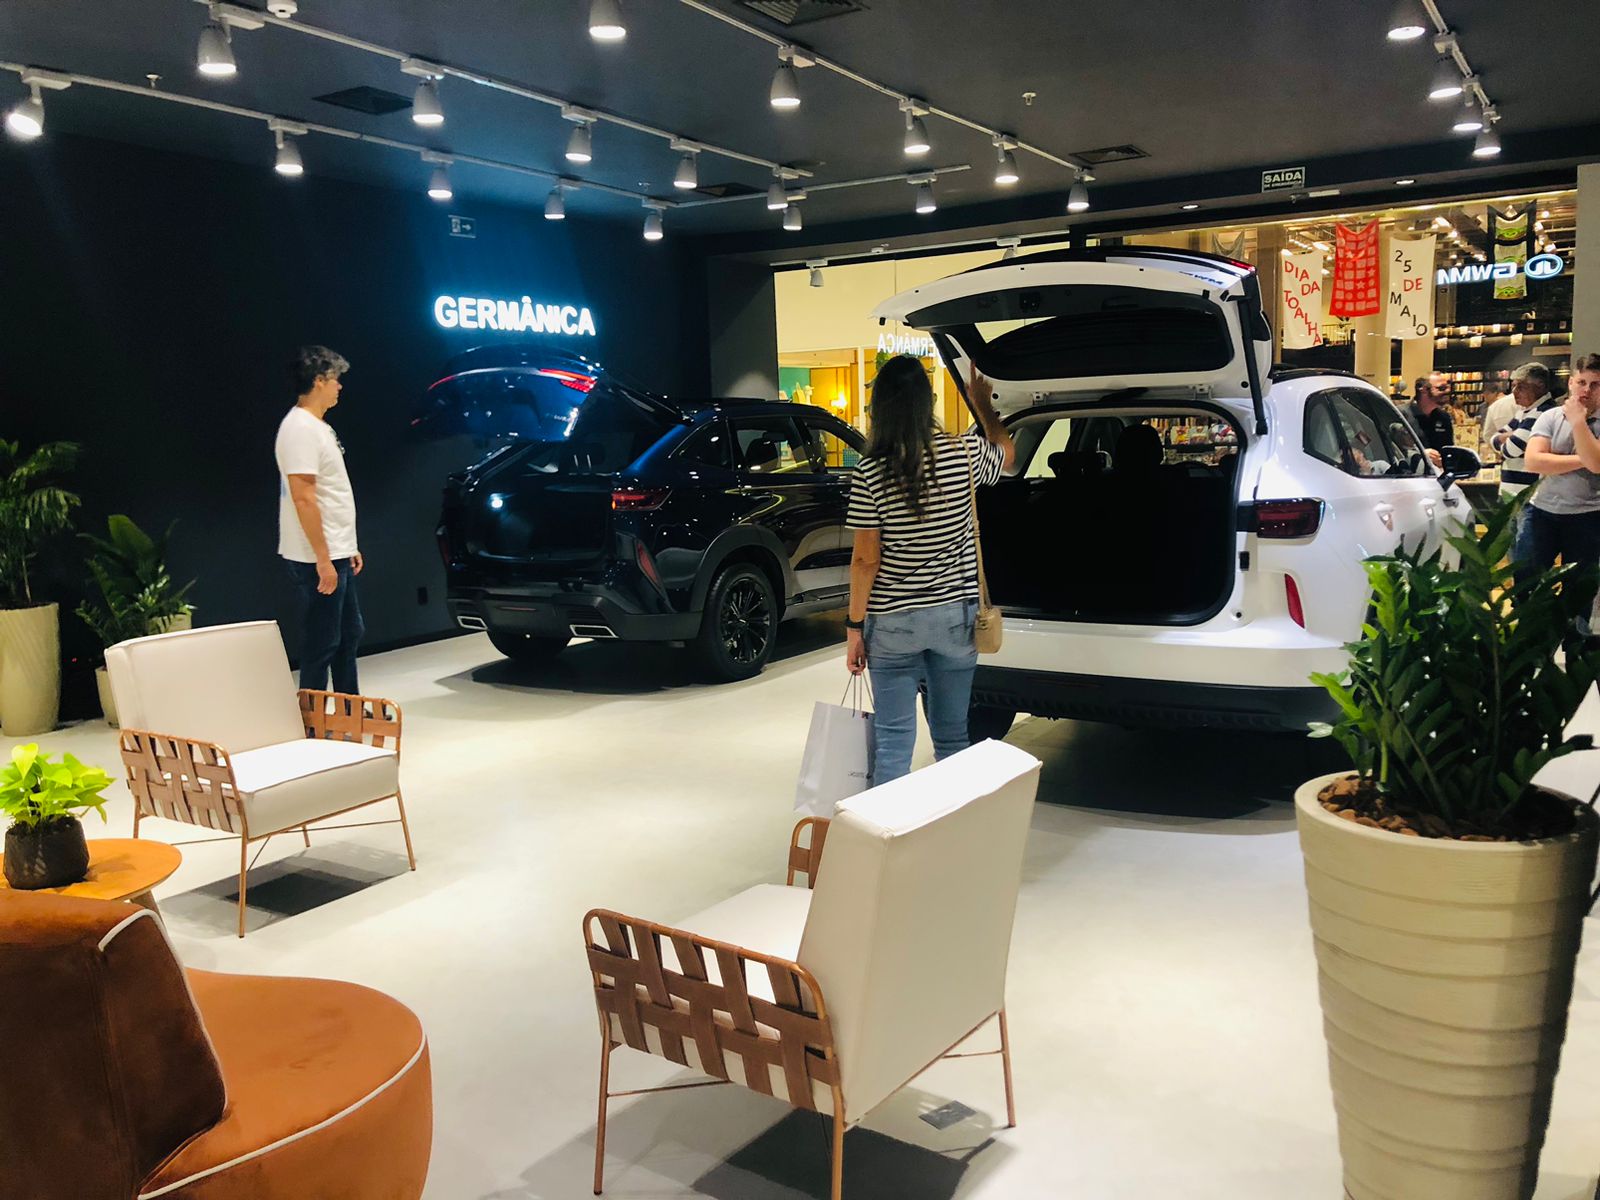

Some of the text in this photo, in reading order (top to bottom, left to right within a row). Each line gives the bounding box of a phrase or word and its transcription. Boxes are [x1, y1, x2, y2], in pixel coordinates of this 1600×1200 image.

[1284, 260, 1310, 281] DIA
[1394, 249, 1412, 273] 25
[1301, 281, 1321, 296] DA
[1403, 278, 1423, 292] DE
[434, 295, 596, 336] GERMÂNICA
[1284, 290, 1322, 345] TOALHA
[1390, 291, 1428, 336] MAIO
